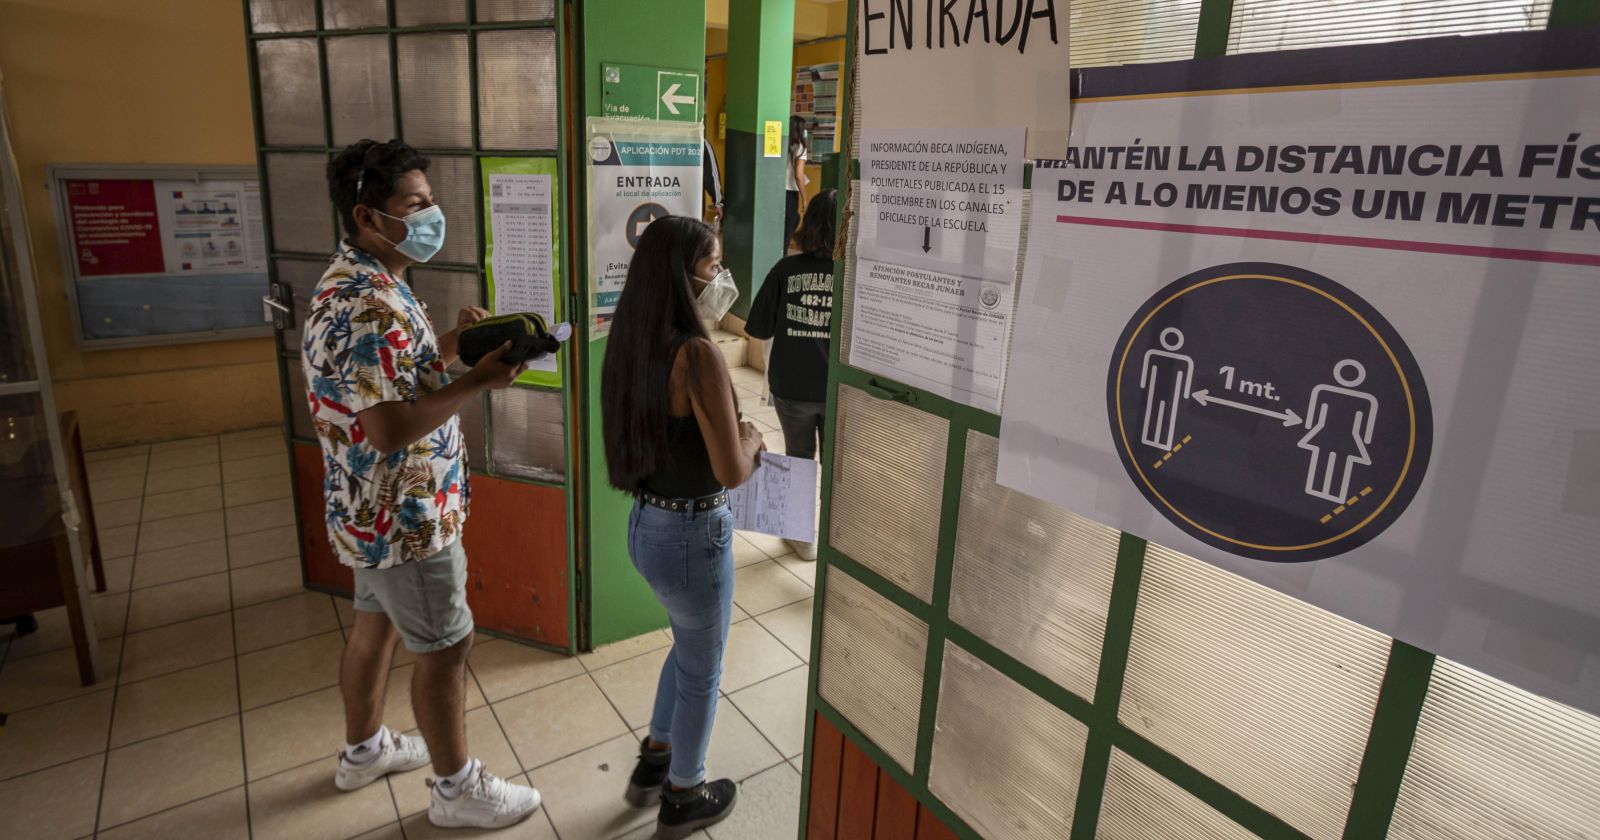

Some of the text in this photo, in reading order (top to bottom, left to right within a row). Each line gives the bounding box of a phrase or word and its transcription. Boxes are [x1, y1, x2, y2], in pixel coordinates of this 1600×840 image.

[620, 104, 630, 112] de
[621, 145, 669, 155] APLICACIÓN
[671, 147, 686, 155] PDT
[870, 141, 1008, 157] INFORMACIÓN BECA INDÍGENA,
[871, 160, 1007, 175] PRESIDENTE DE LA REPÚBLICA Y
[1177, 145, 1226, 172] LA
[1235, 144, 1504, 178] DISTANCIA
[616, 176, 681, 188] ENTRADA
[871, 177, 1005, 195] POLIMETALES PUBLICADA EL 15
[651, 189, 682, 198] aplicación
[1057, 179, 1095, 203] DE
[1104, 181, 1128, 205] A
[1134, 182, 1178, 208] LO
[1185, 183, 1342, 217] MENOS
[1351, 189, 1426, 222] UN
[870, 194, 1004, 215] DE DICIEMBRE EN LOS CANALES
[879, 212, 989, 233] OFICIALES DE LA ESCUELA.
[870, 271, 911, 286] RENOVANTES
[912, 279, 935, 290] BECAS
[935, 284, 965, 297] JUNAEB
[872, 264, 963, 287] ATENCIÓN POSTULANTES Y
[1219, 365, 1280, 401] 1 mt.
